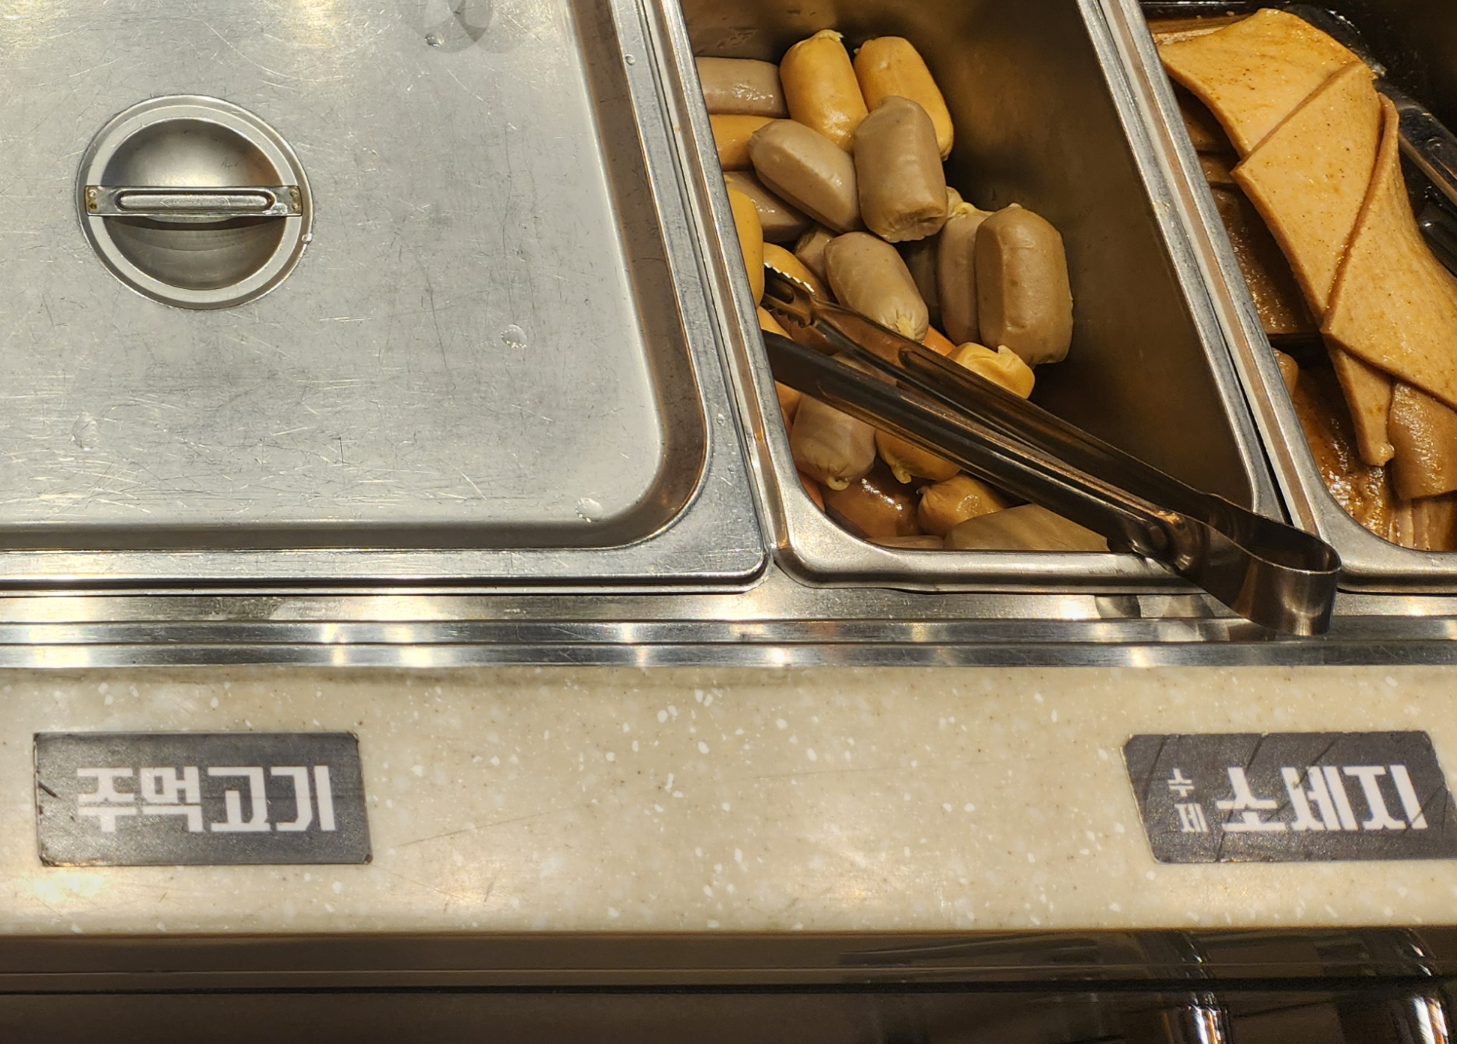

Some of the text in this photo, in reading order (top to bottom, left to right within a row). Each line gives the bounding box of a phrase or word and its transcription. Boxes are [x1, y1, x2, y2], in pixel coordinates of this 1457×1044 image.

[75, 765, 336, 834] 주먹고기
[1167, 765, 1428, 834] 수제 소세지
